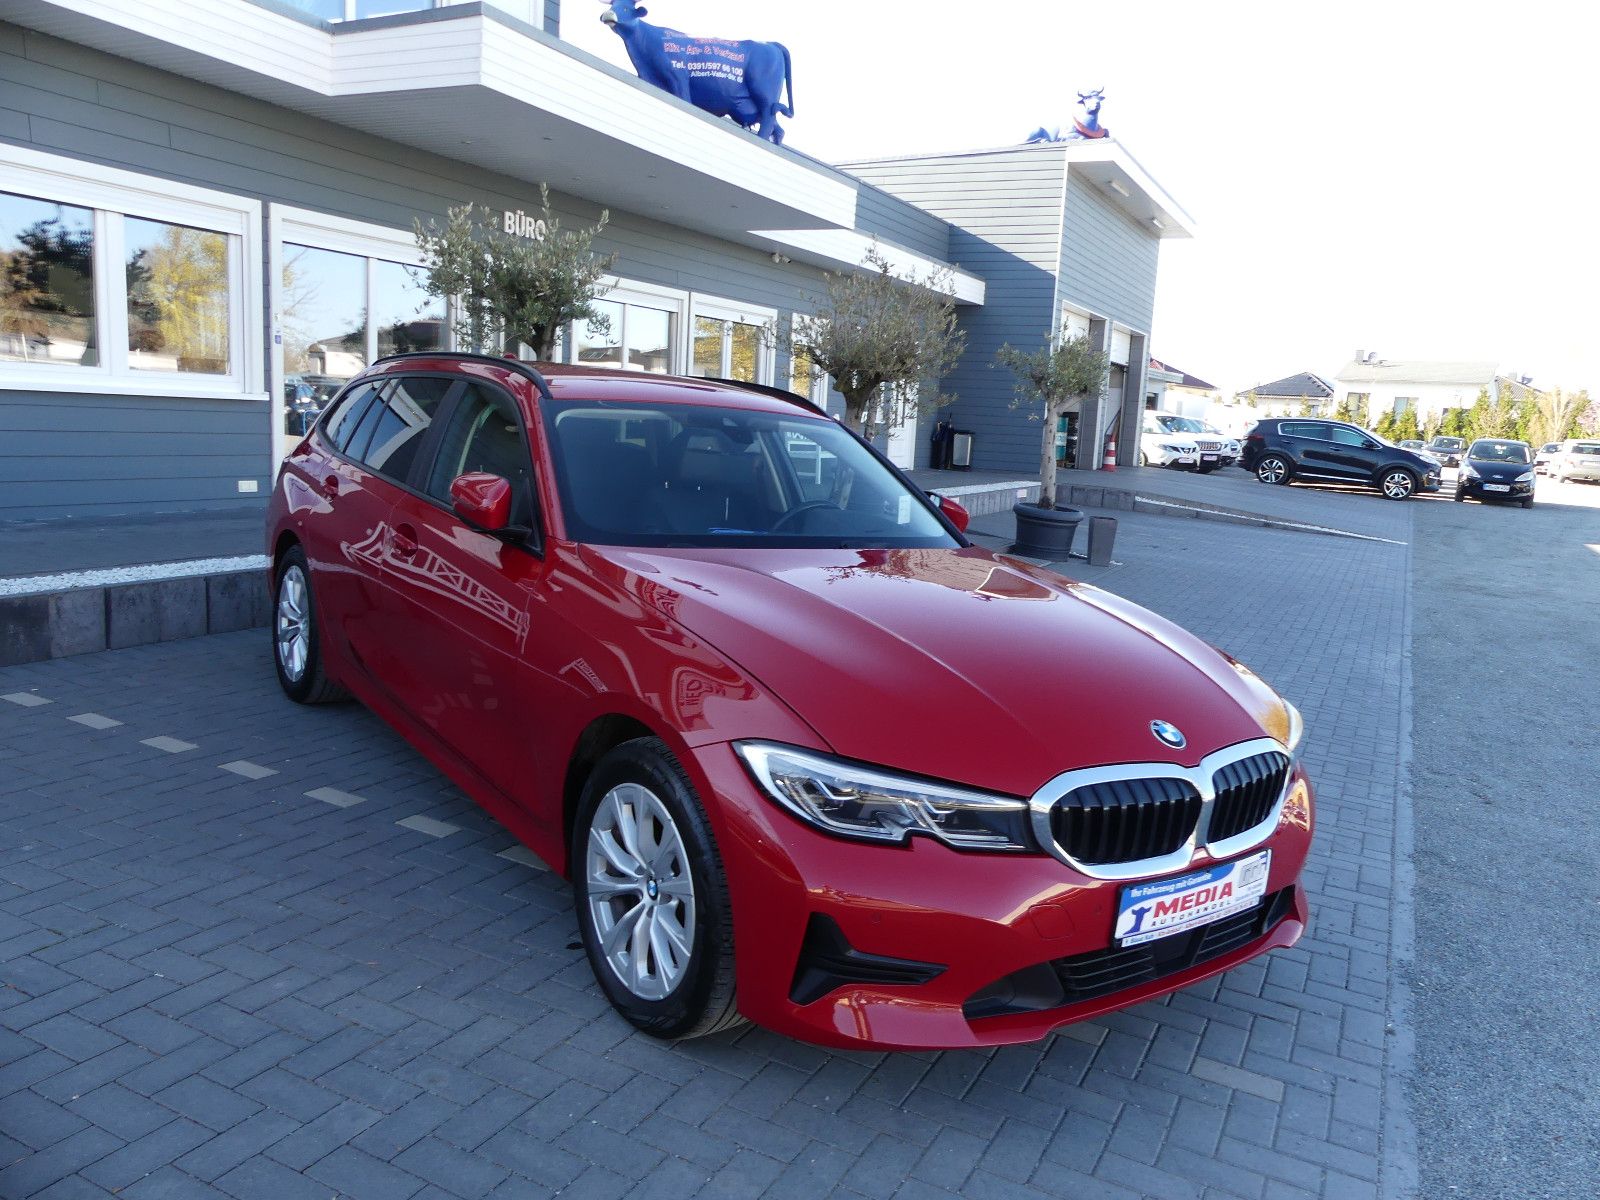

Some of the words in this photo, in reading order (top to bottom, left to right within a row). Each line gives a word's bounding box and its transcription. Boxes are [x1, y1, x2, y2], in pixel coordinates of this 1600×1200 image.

[671, 60, 686, 69] Tel.
[503, 209, 546, 241] BÜRO
[1151, 899, 1232, 928] AUTOHANDEL
[1153, 881, 1233, 919] MEDIA
